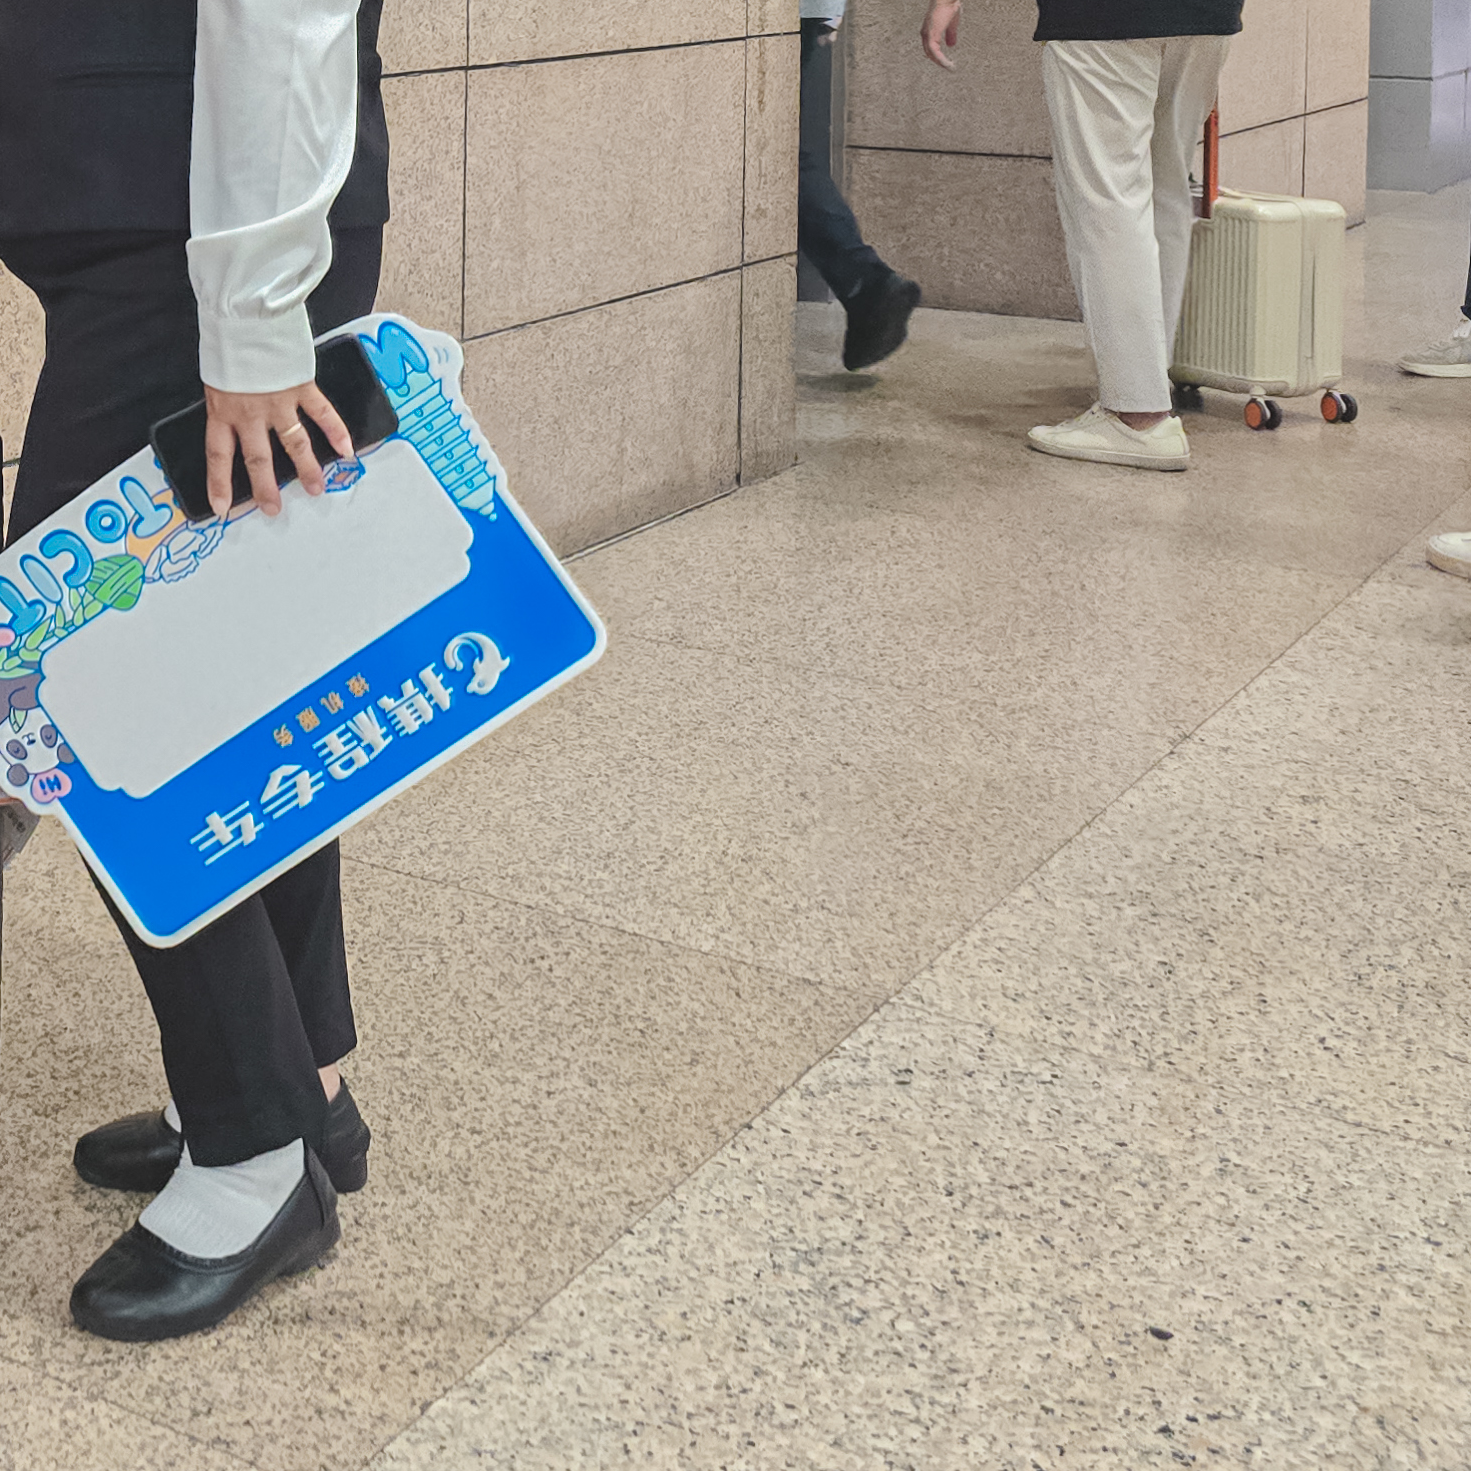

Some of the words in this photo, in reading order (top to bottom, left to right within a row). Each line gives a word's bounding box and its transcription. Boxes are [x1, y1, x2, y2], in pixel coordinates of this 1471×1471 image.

[273, 672, 370, 748] 接机服务
[39, 774, 62, 796] Hi
[189, 662, 454, 867] 携程专车
